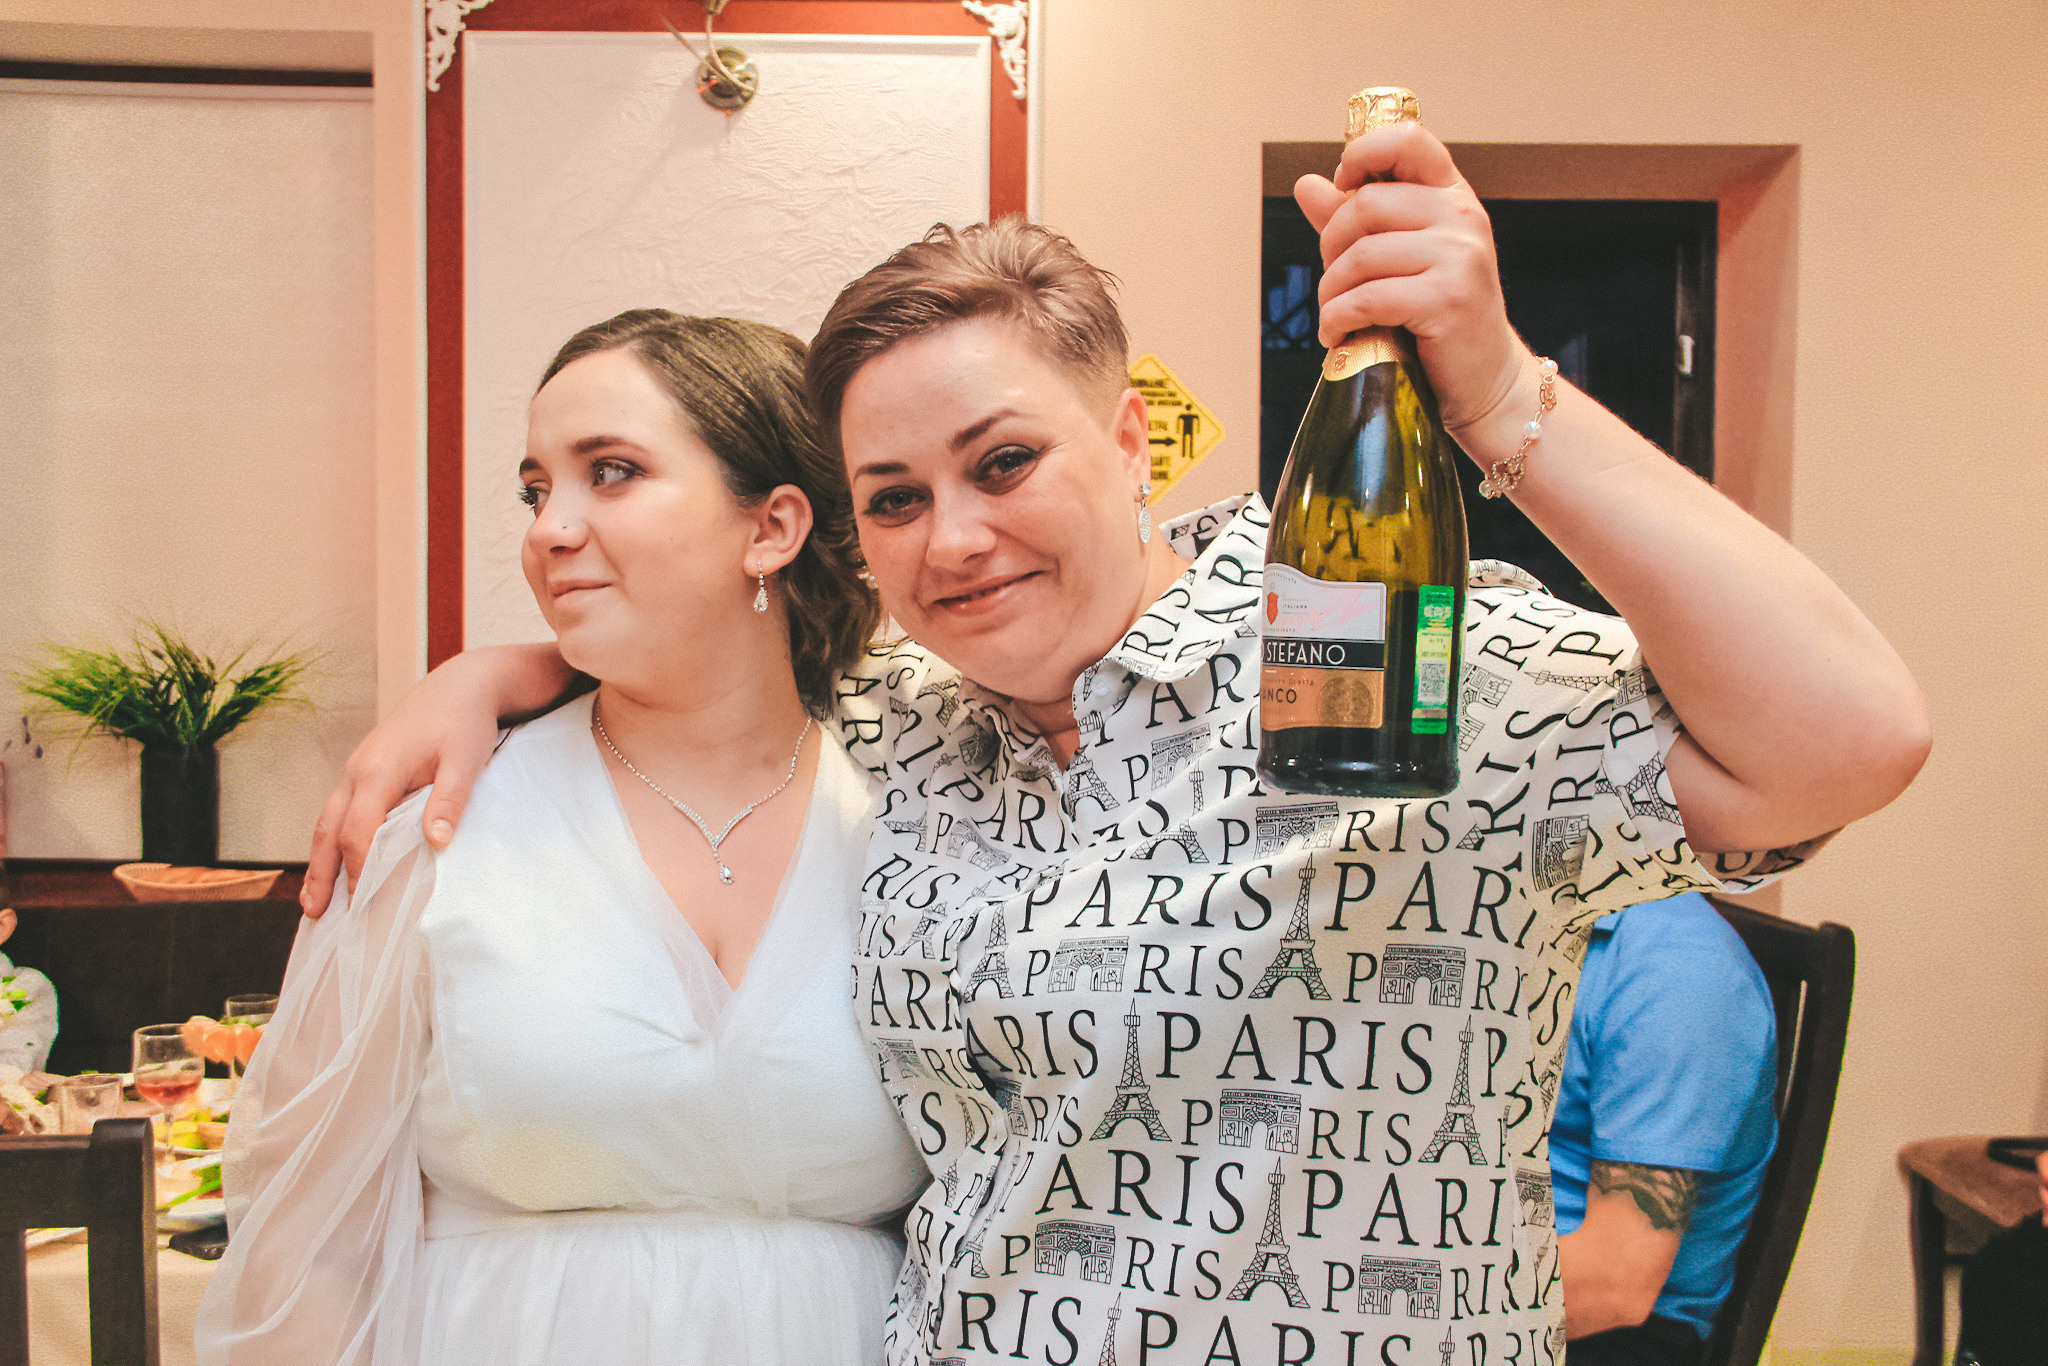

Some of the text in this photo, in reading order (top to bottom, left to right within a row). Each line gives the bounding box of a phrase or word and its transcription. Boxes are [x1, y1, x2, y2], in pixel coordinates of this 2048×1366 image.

[1266, 641, 1346, 666] STEFANO
[934, 773, 1080, 853] PARI
[1016, 866, 1273, 933] PARIS
[1156, 1011, 1433, 1096] PARIS
[999, 1148, 1245, 1235] PARIS
